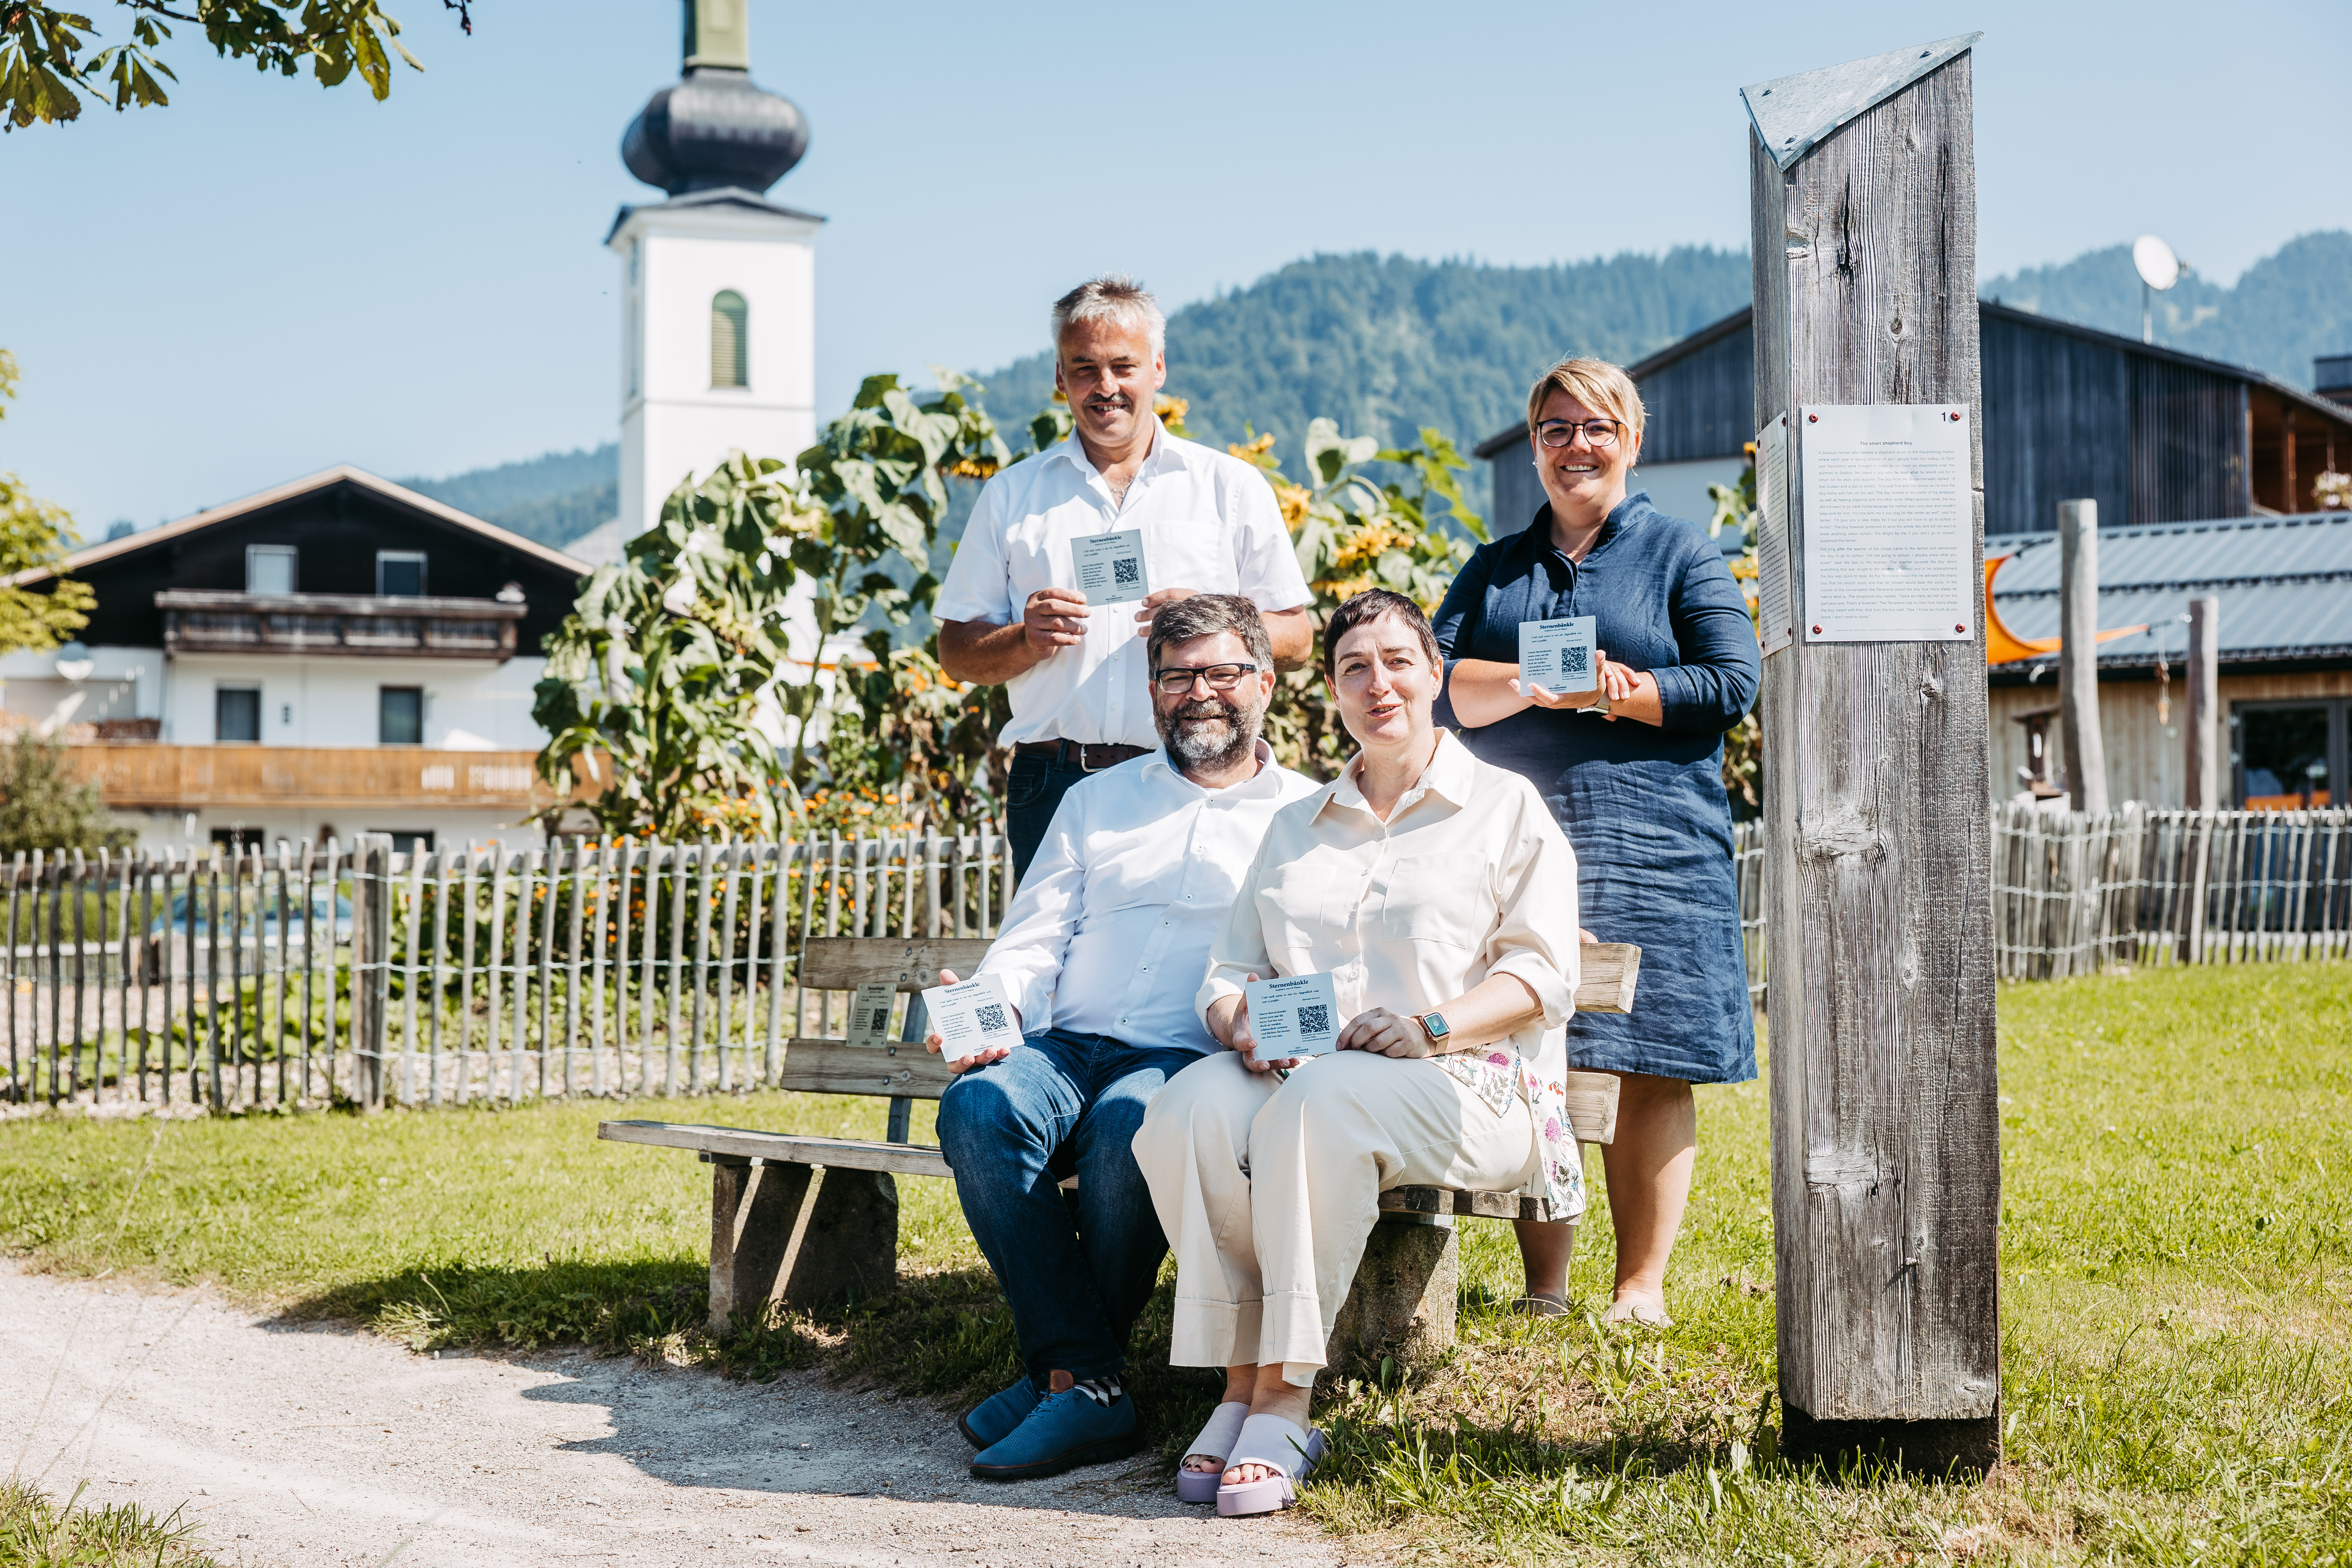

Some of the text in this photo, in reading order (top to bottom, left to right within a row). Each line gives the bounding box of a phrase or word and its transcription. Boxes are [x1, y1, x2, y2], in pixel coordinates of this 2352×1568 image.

[1941, 412, 1946, 422] 1
[1090, 535, 1122, 544] Sternenbänkle
[944, 982, 980, 994] Sternenbänkle
[1269, 980, 1308, 988] Sternenbänkle
